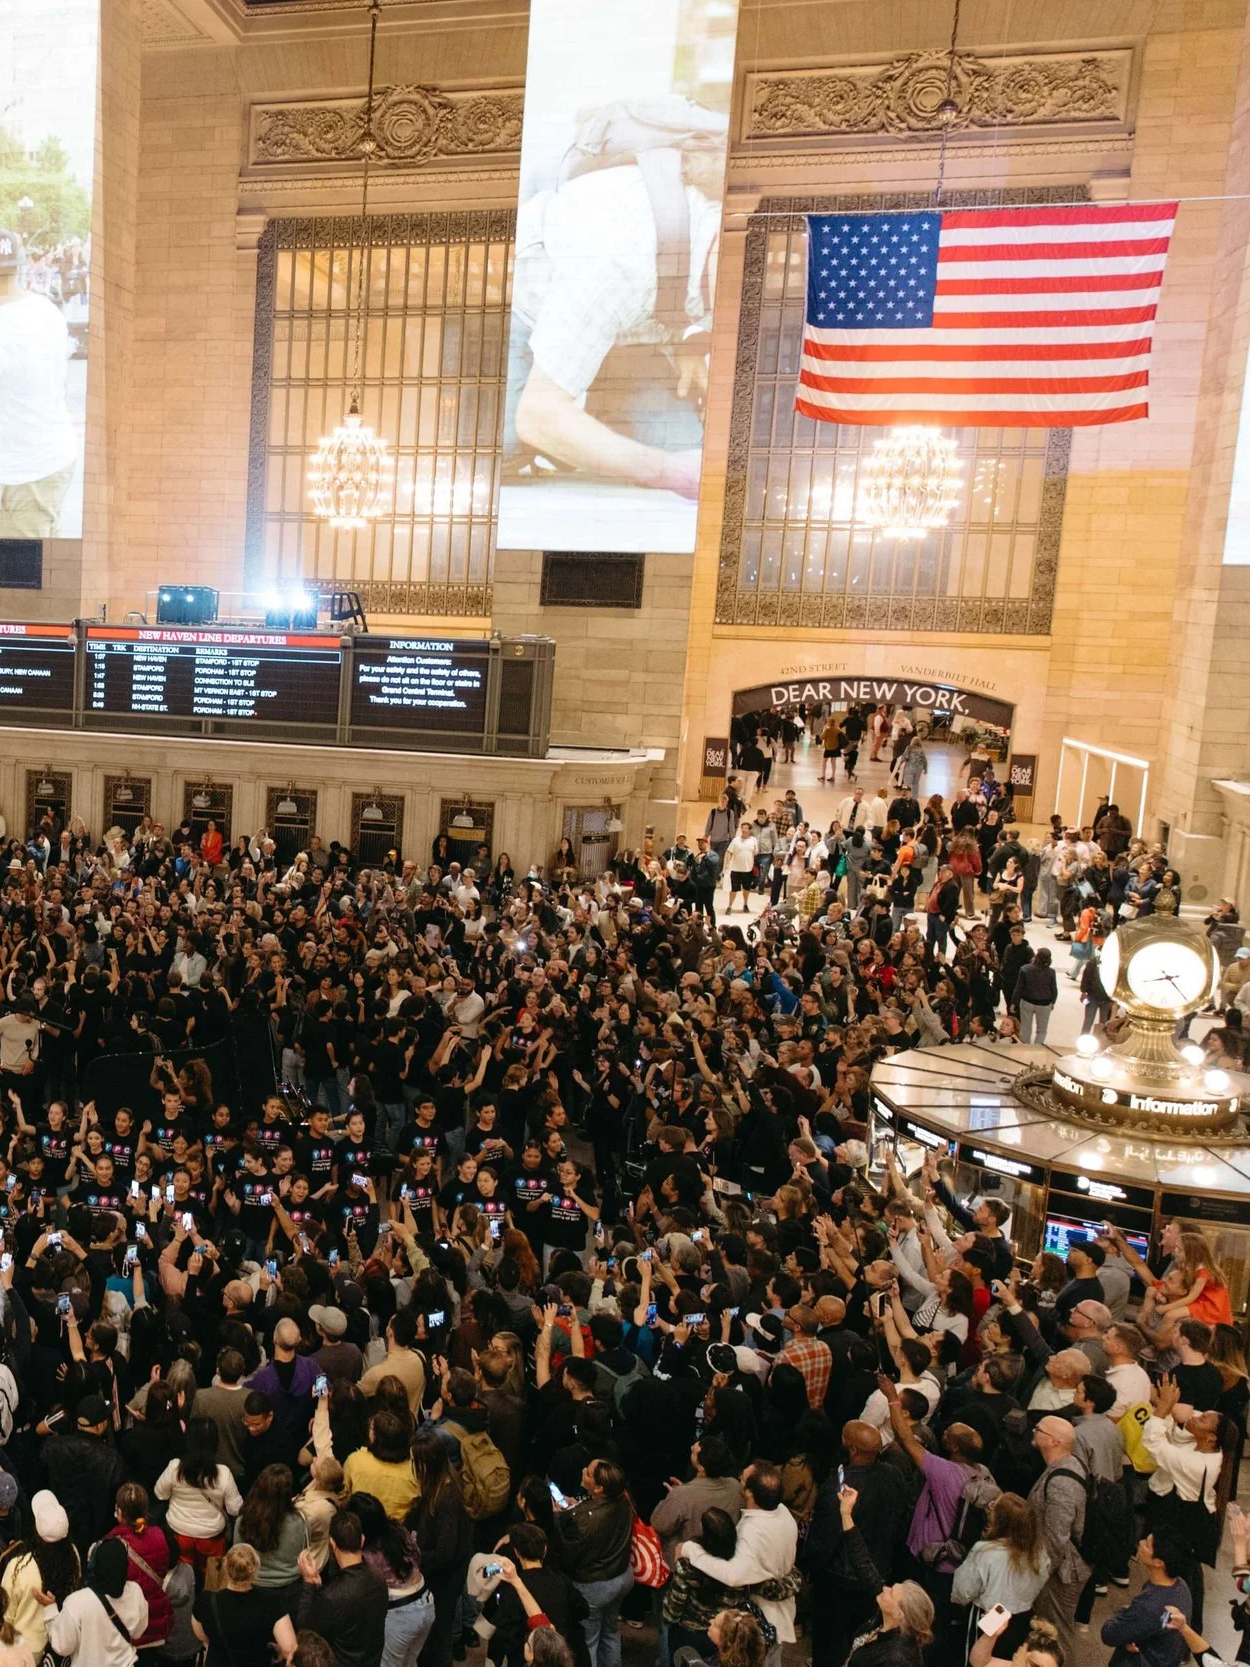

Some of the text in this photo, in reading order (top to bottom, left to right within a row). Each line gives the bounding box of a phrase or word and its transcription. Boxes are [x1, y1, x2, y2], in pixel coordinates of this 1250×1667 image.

[139, 631, 286, 644] NEW HAVEN LINE DEPARTURES
[390, 641, 454, 651] INFORMATION
[416, 657, 452, 665] Customers:
[386, 666, 406, 674] safety
[431, 668, 450, 677] safety
[459, 670, 481, 678] others,
[780, 662, 848, 675] 42ND STREET
[359, 675, 380, 683] please
[900, 665, 997, 691] VANDERBILT HALL
[382, 686, 455, 697] Grand Central Terminal.
[771, 681, 970, 714] DEAR NEW YORK,
[428, 699, 466, 708] cooperation.
[1130, 1094, 1218, 1116] Information
